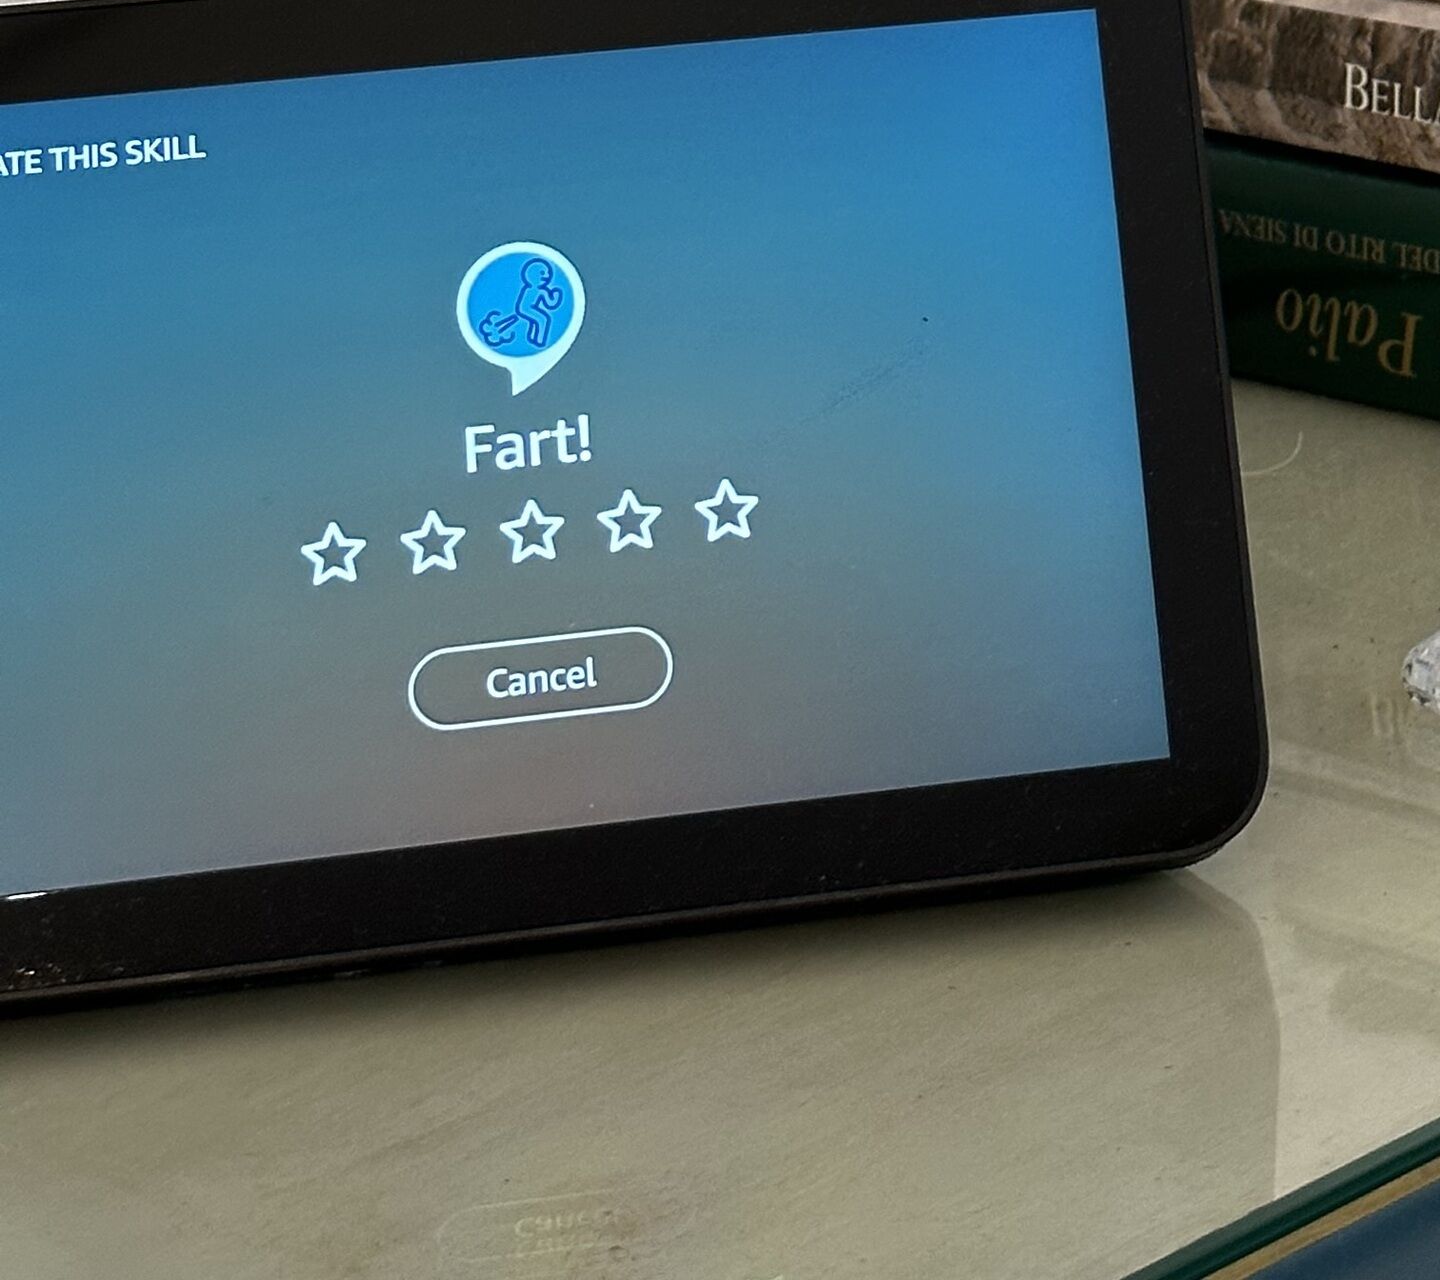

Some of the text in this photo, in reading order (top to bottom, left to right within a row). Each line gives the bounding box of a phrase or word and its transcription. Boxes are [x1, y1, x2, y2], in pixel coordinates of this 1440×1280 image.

[48, 141, 119, 172] THIS
[125, 134, 207, 167] SKILL
[1218, 207, 1286, 242] SIENA
[1294, 222, 1318, 252] DI
[1327, 227, 1386, 263] RITO
[1399, 241, 1440, 275] DEL
[1274, 286, 1424, 378] Palio
[464, 412, 593, 473] Fart!
[486, 656, 598, 700] Cancel
